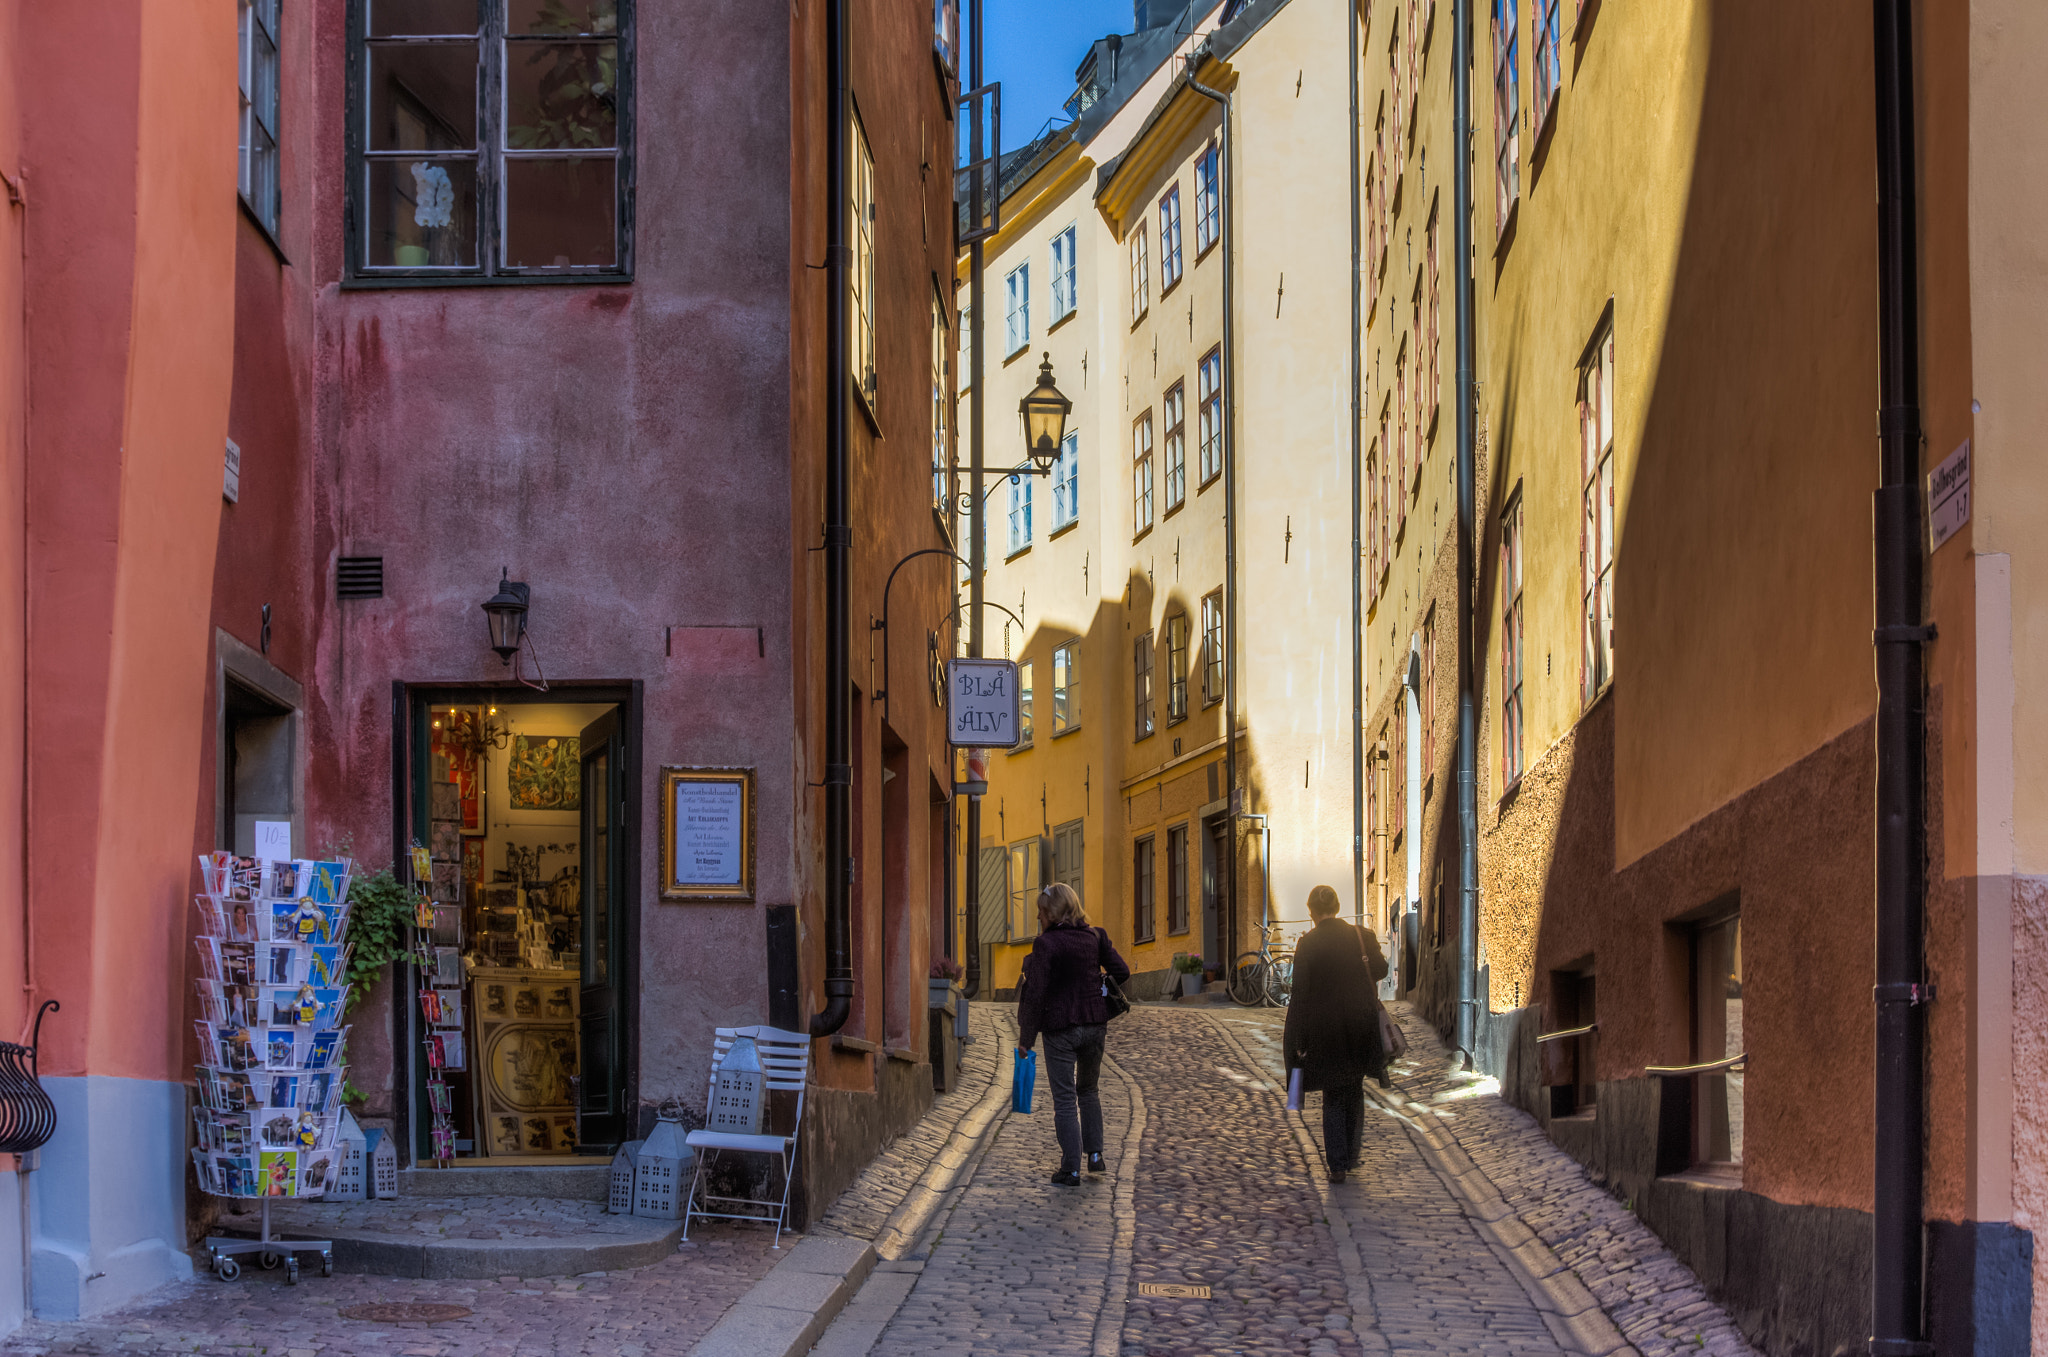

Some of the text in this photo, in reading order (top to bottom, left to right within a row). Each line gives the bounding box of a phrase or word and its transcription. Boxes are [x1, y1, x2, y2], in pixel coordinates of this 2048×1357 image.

[1932, 445, 1968, 500] Bollhusgränd
[262, 602, 272, 655] 8
[958, 670, 1006, 697] BLÅ
[957, 706, 1008, 733] ÄLV
[682, 788, 737, 796] Konstbokhandel
[697, 796, 716, 804] Book
